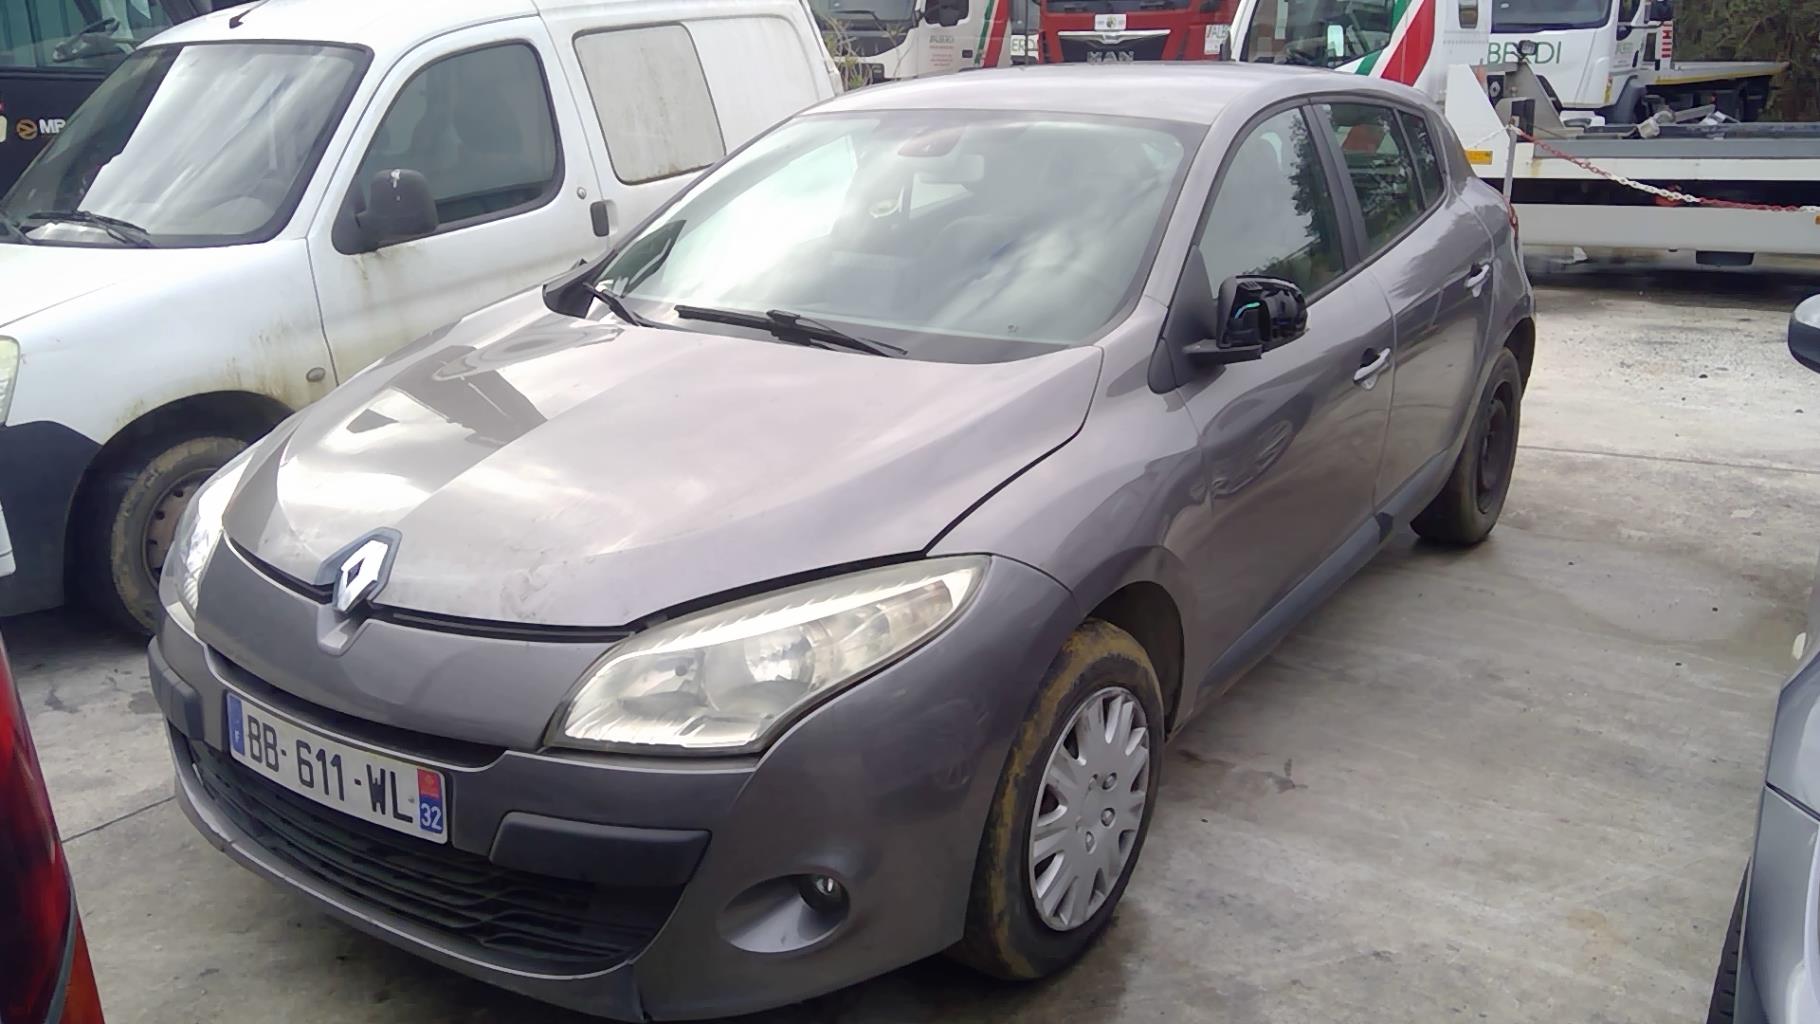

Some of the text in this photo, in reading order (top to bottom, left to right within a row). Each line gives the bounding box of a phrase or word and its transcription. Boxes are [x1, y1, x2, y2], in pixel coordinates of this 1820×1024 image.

[1087, 50, 1134, 64] MAN
[1487, 40, 1562, 64] BEDI
[247, 714, 413, 824] BB-611-WL
[420, 802, 442, 830] 32
